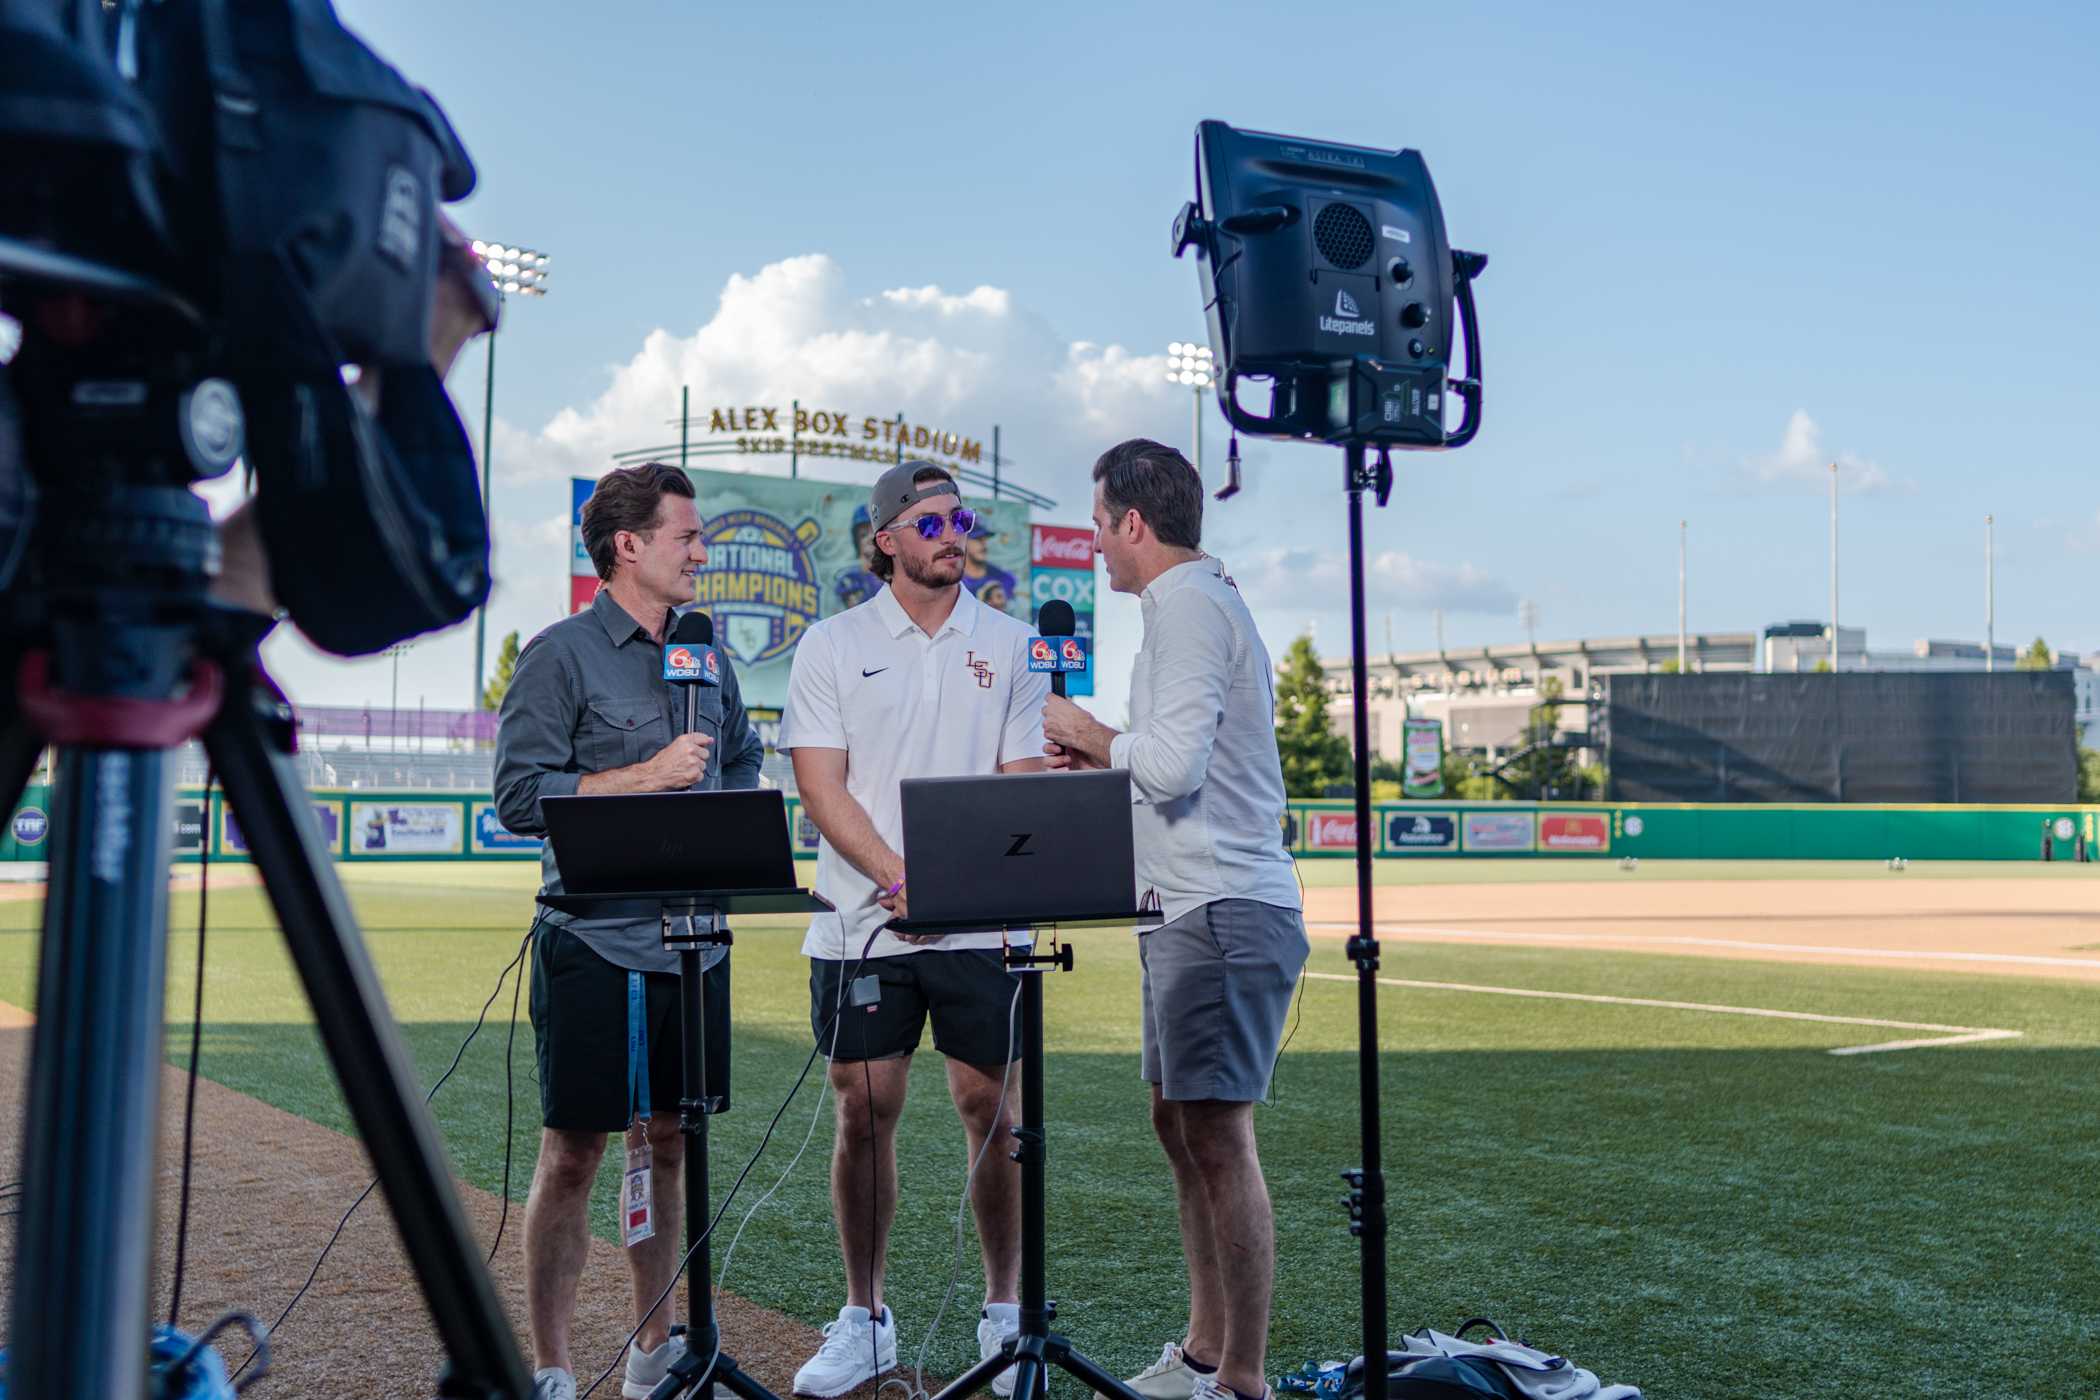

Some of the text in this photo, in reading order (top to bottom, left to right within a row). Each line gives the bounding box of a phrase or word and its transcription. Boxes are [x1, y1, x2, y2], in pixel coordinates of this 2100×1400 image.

[1320, 316, 1375, 335] Litepanels
[710, 408, 777, 432] ALEX
[795, 409, 848, 438] BOX
[863, 417, 982, 464] STADIUM
[695, 573, 818, 616] HAMPIONS
[1032, 574, 1093, 604] COX
[667, 669, 699, 677] WDSU
[965, 650, 995, 689] LSU
[1031, 661, 1057, 669] WDSU
[1003, 833, 1035, 857] Z
